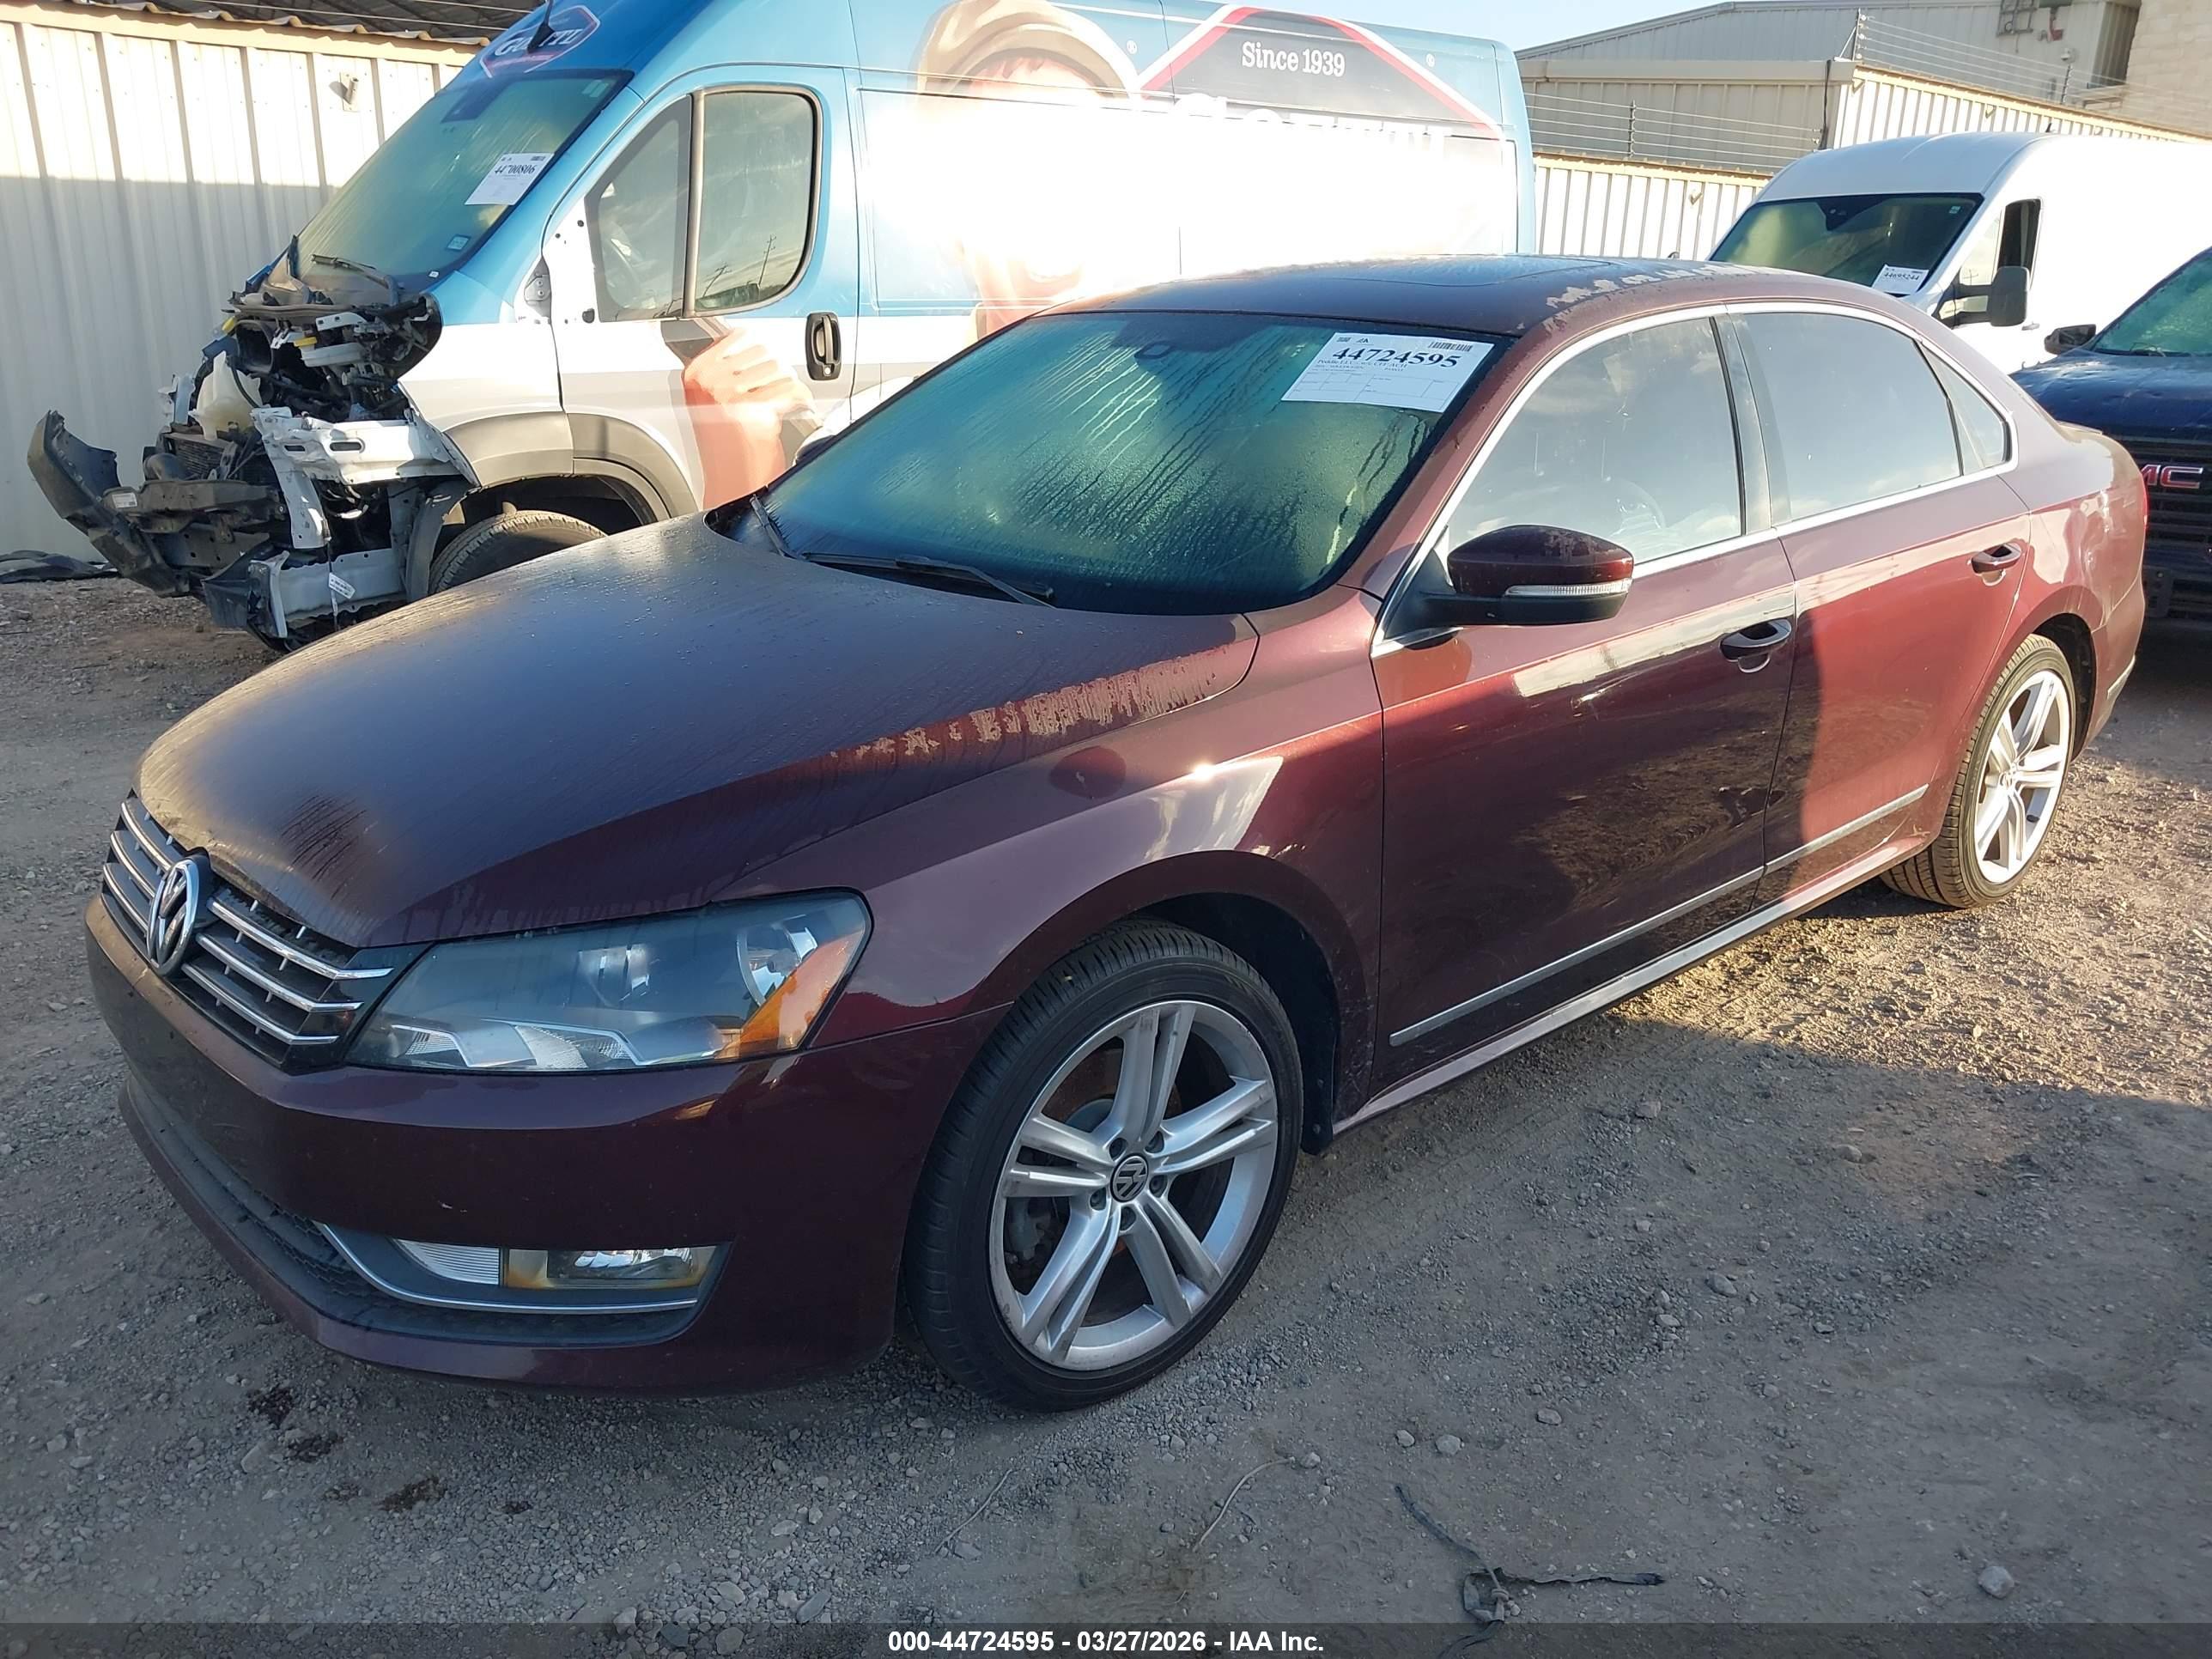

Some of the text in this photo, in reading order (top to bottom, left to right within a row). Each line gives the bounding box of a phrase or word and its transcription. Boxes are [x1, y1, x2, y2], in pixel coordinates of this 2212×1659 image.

[1242, 40, 1346, 77] Since 1939
[1332, 347, 1462, 368] 44724595
